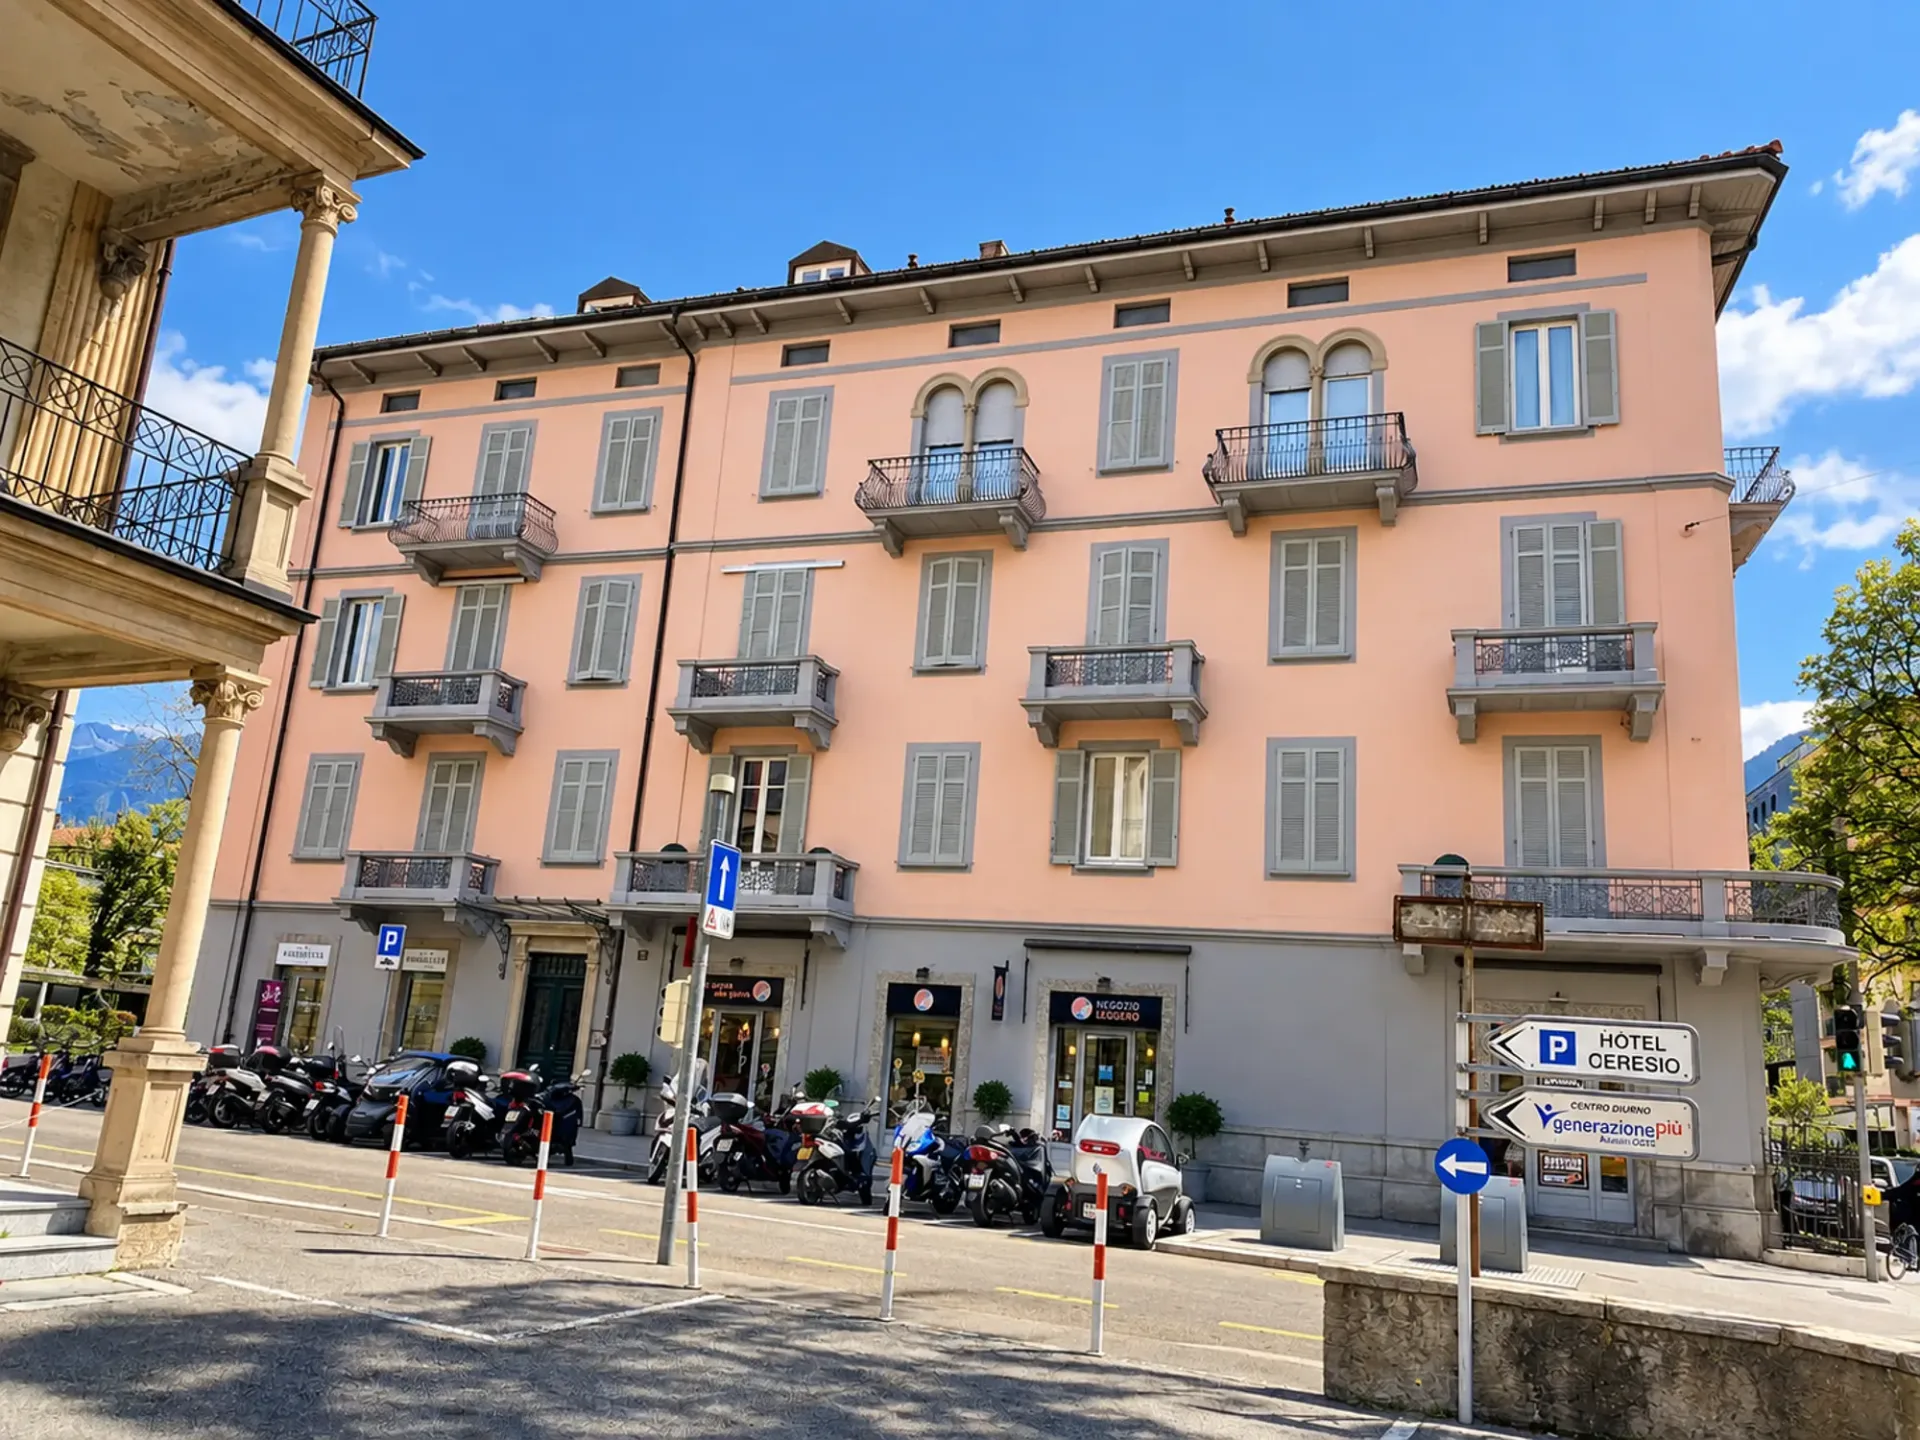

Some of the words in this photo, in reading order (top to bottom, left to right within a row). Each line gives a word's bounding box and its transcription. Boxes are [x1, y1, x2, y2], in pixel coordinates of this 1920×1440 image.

[384, 931, 398, 951] P
[1549, 1035, 1568, 1061] P
[1570, 1101, 1610, 1113] CENTRO
[1612, 1104, 1651, 1115] DIURNO
